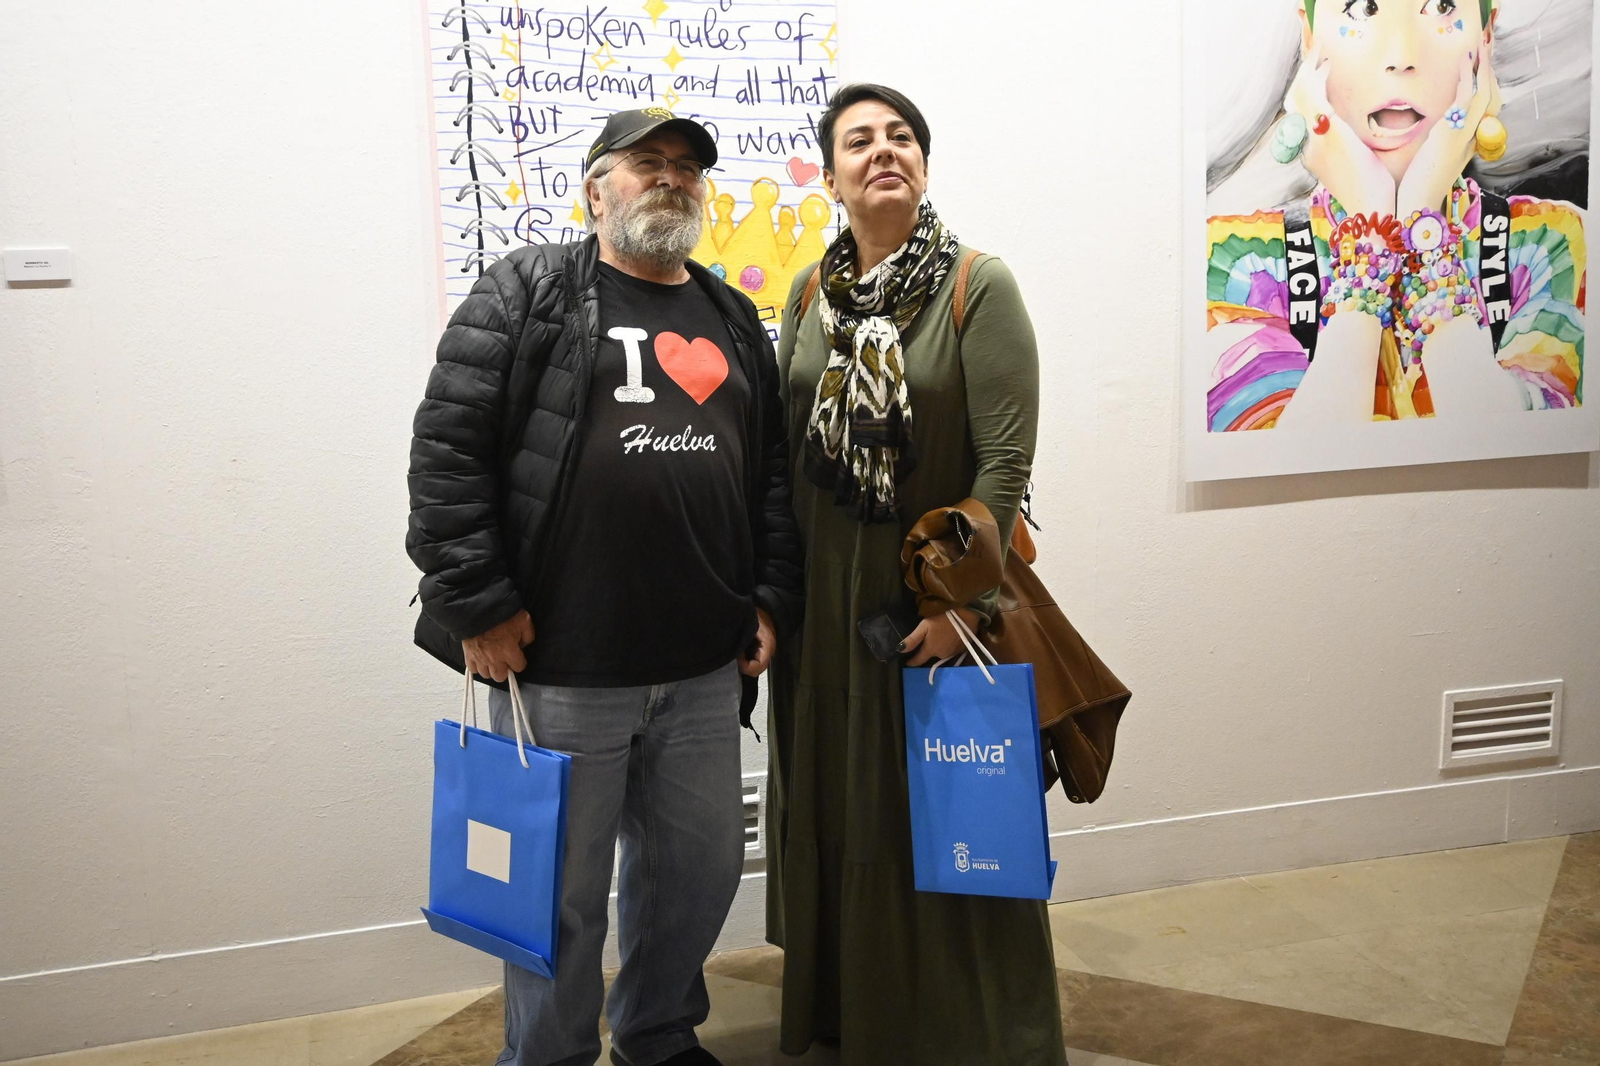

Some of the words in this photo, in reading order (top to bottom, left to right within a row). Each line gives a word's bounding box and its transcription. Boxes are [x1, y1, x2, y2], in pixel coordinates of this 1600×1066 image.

[500, 5, 645, 59] unspoken
[670, 7, 750, 51] rules
[775, 13, 814, 65] of
[506, 48, 654, 102] academia
[674, 64, 720, 98] and
[736, 66, 761, 106] all
[771, 65, 836, 106] that
[737, 113, 820, 155] want
[530, 157, 568, 198] to
[1286, 228, 1317, 325] FACE
[1482, 214, 1512, 324] STYLE
[607, 326, 655, 403] I
[619, 424, 717, 454] Huelva
[924, 738, 1005, 763] Huelva
[976, 766, 1006, 777] original
[972, 862, 1000, 870] HUELVA
